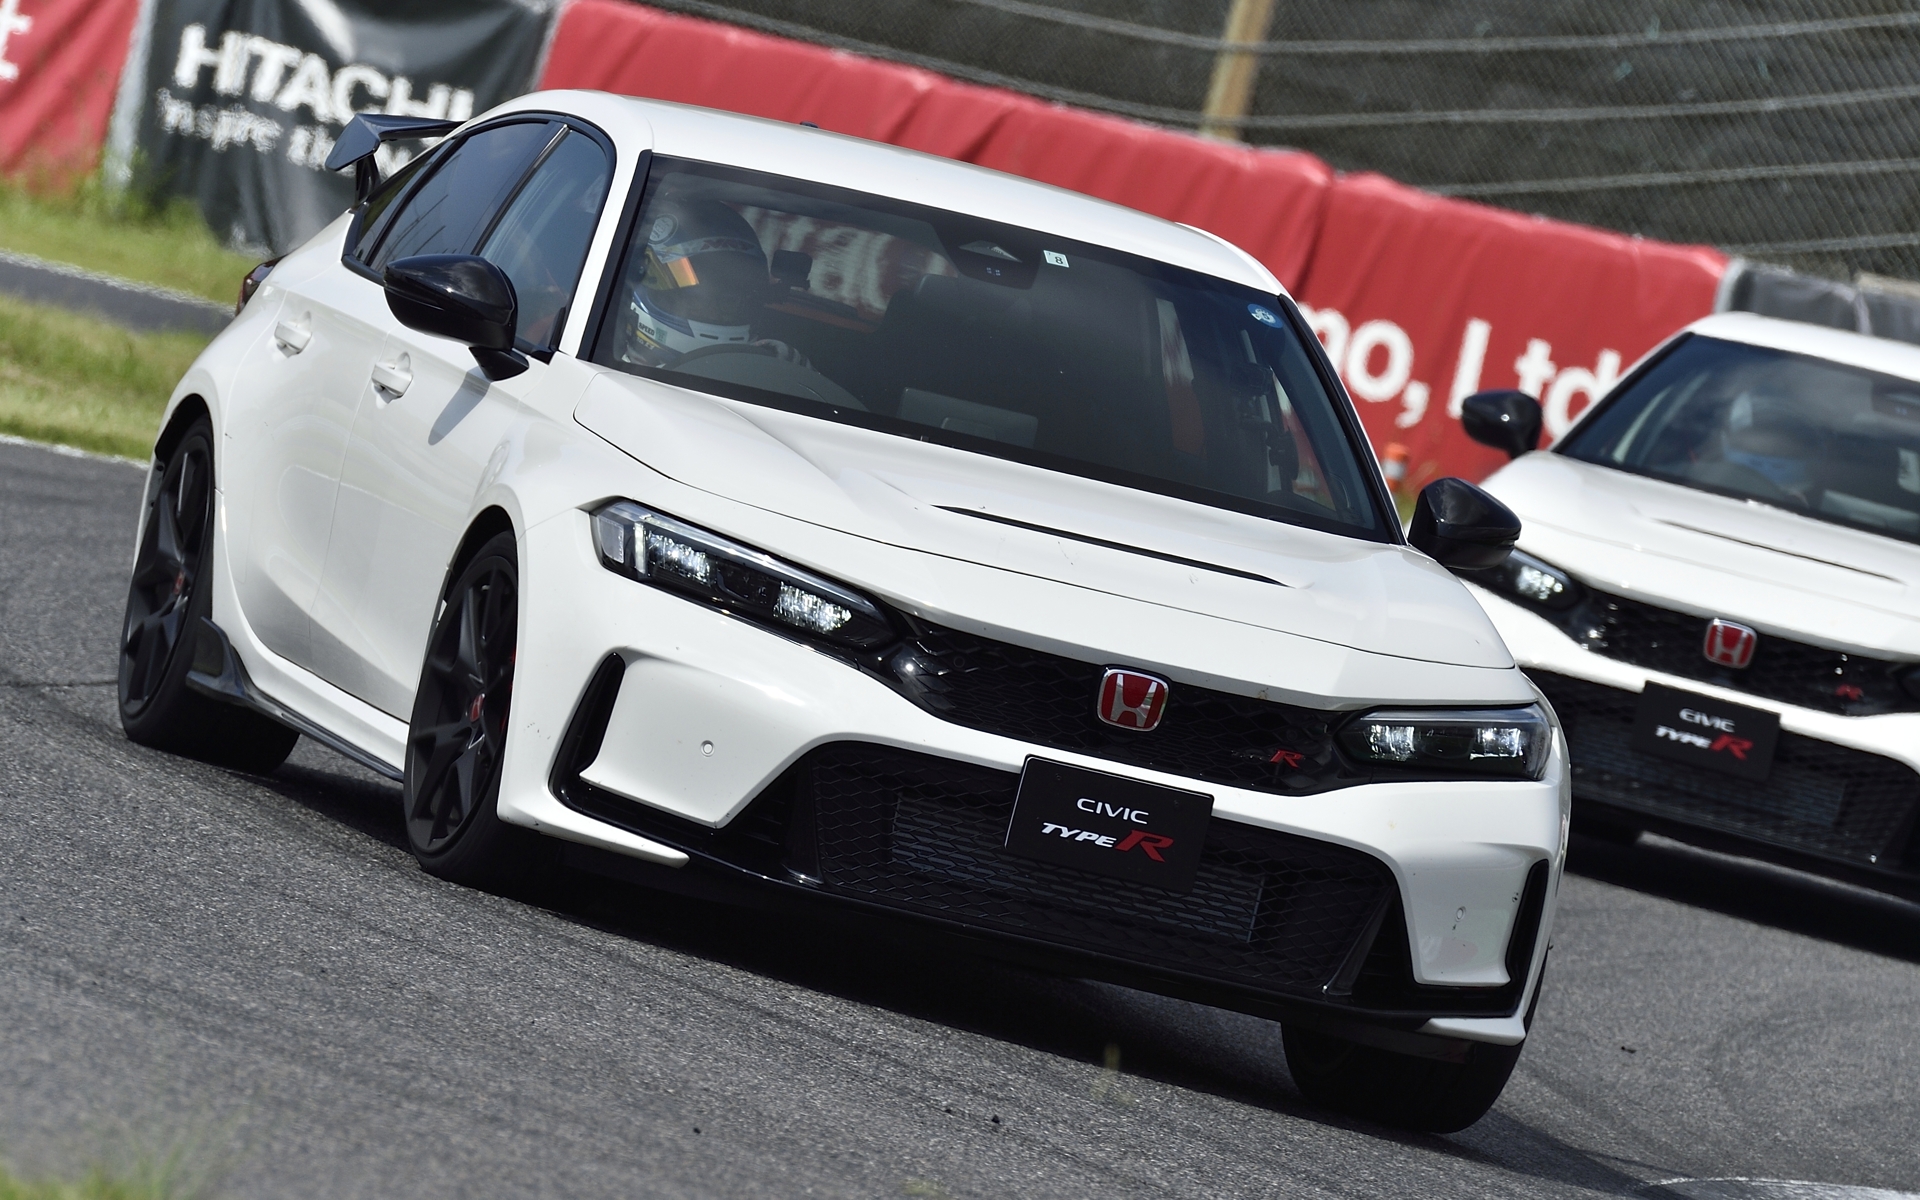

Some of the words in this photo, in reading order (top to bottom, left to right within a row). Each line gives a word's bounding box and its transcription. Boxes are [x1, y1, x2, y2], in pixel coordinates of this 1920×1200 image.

[174, 23, 475, 126] HITACHI
[1679, 708, 1735, 733] CIVIC
[1655, 724, 1711, 749] TYPE
[1709, 733, 1753, 760] R
[1076, 798, 1149, 824] CIVIC
[1041, 822, 1117, 847] TYPE
[1115, 829, 1174, 862] R
